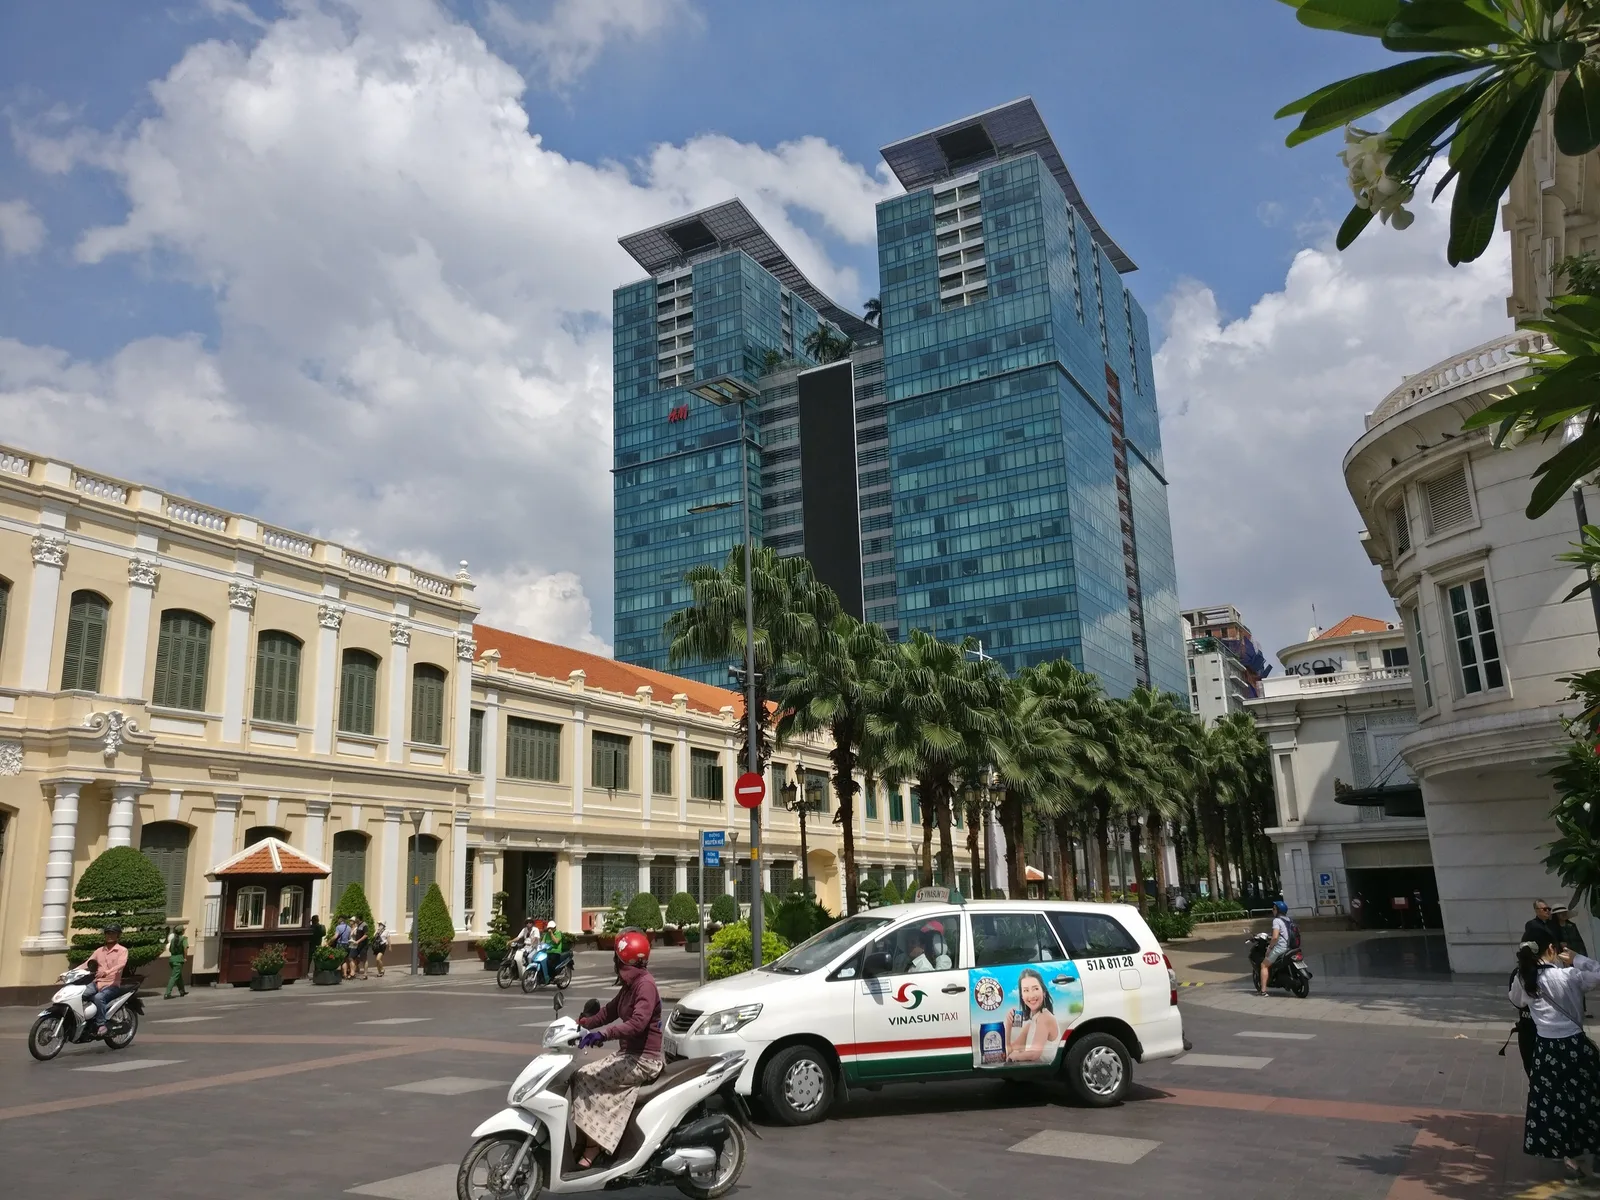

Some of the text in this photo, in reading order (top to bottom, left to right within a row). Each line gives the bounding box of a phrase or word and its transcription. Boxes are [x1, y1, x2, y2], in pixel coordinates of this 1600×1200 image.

[1086, 955, 1134, 972] 51A 811 28
